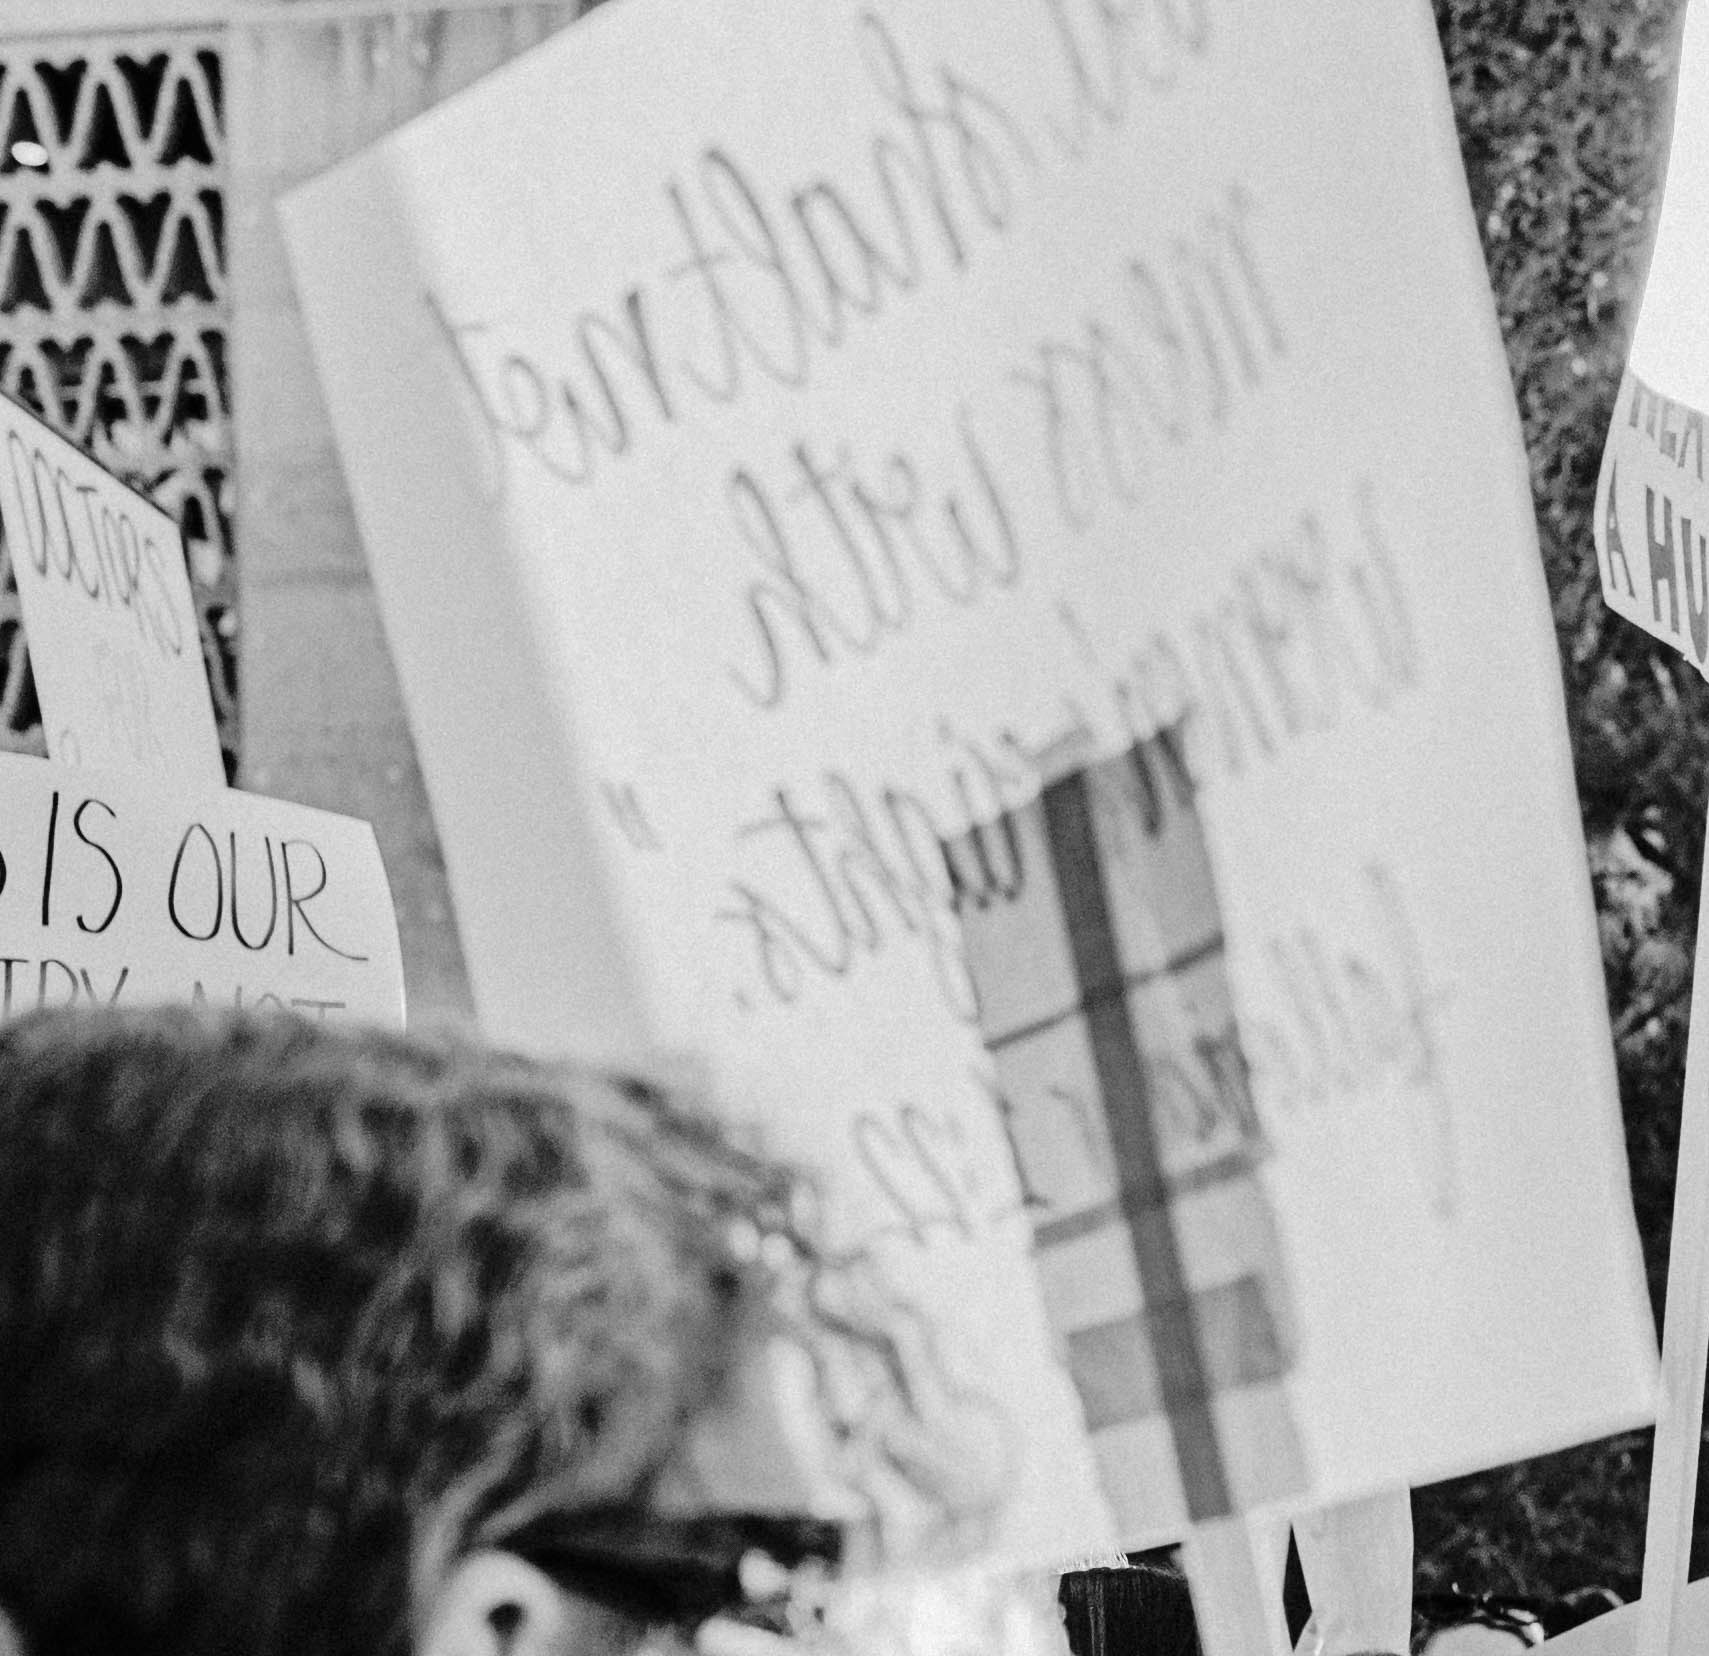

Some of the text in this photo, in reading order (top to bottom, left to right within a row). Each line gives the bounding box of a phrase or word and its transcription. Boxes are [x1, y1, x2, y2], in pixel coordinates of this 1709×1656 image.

[1605, 457, 1637, 600] A
[41, 791, 370, 960] IS OUR
